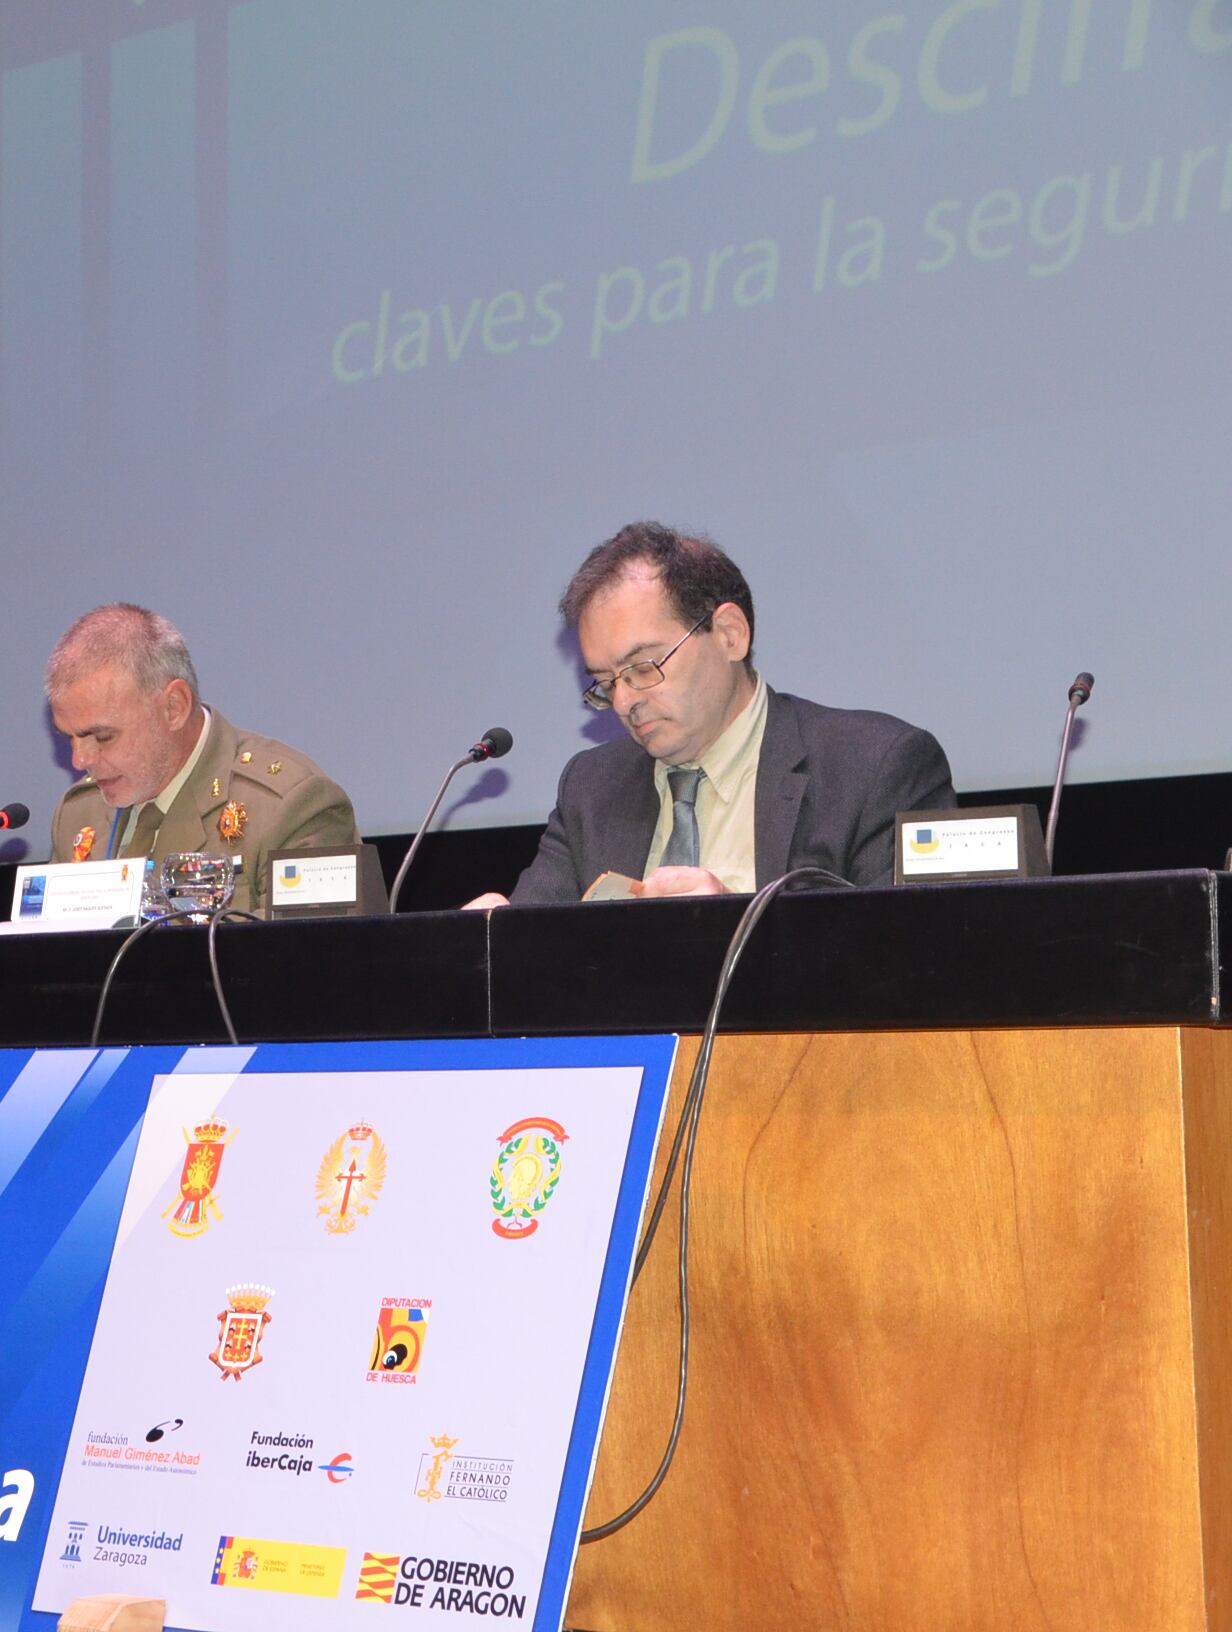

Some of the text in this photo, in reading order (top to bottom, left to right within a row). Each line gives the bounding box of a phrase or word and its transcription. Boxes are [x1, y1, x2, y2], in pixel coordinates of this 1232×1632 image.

[331, 280, 565, 383] claves
[590, 237, 780, 360] para
[812, 196, 887, 293] la
[366, 1372, 417, 1384] DE HUESCA
[88, 1431, 129, 1445] fundación
[251, 1431, 314, 1449] Fundación
[84, 1445, 201, 1466] Manuel Giménez Abad
[246, 1450, 313, 1476] iberCaja
[452, 1460, 513, 1472] INSTITUCIÓN
[449, 1471, 510, 1486] FERNANDO
[446, 1485, 508, 1500] EL CATÓLICO
[97, 1525, 183, 1552] Universidad
[93, 1546, 148, 1567] Zaragoza
[400, 1556, 515, 1589] GOBIERNO
[394, 1582, 527, 1619] DE ARAGON
